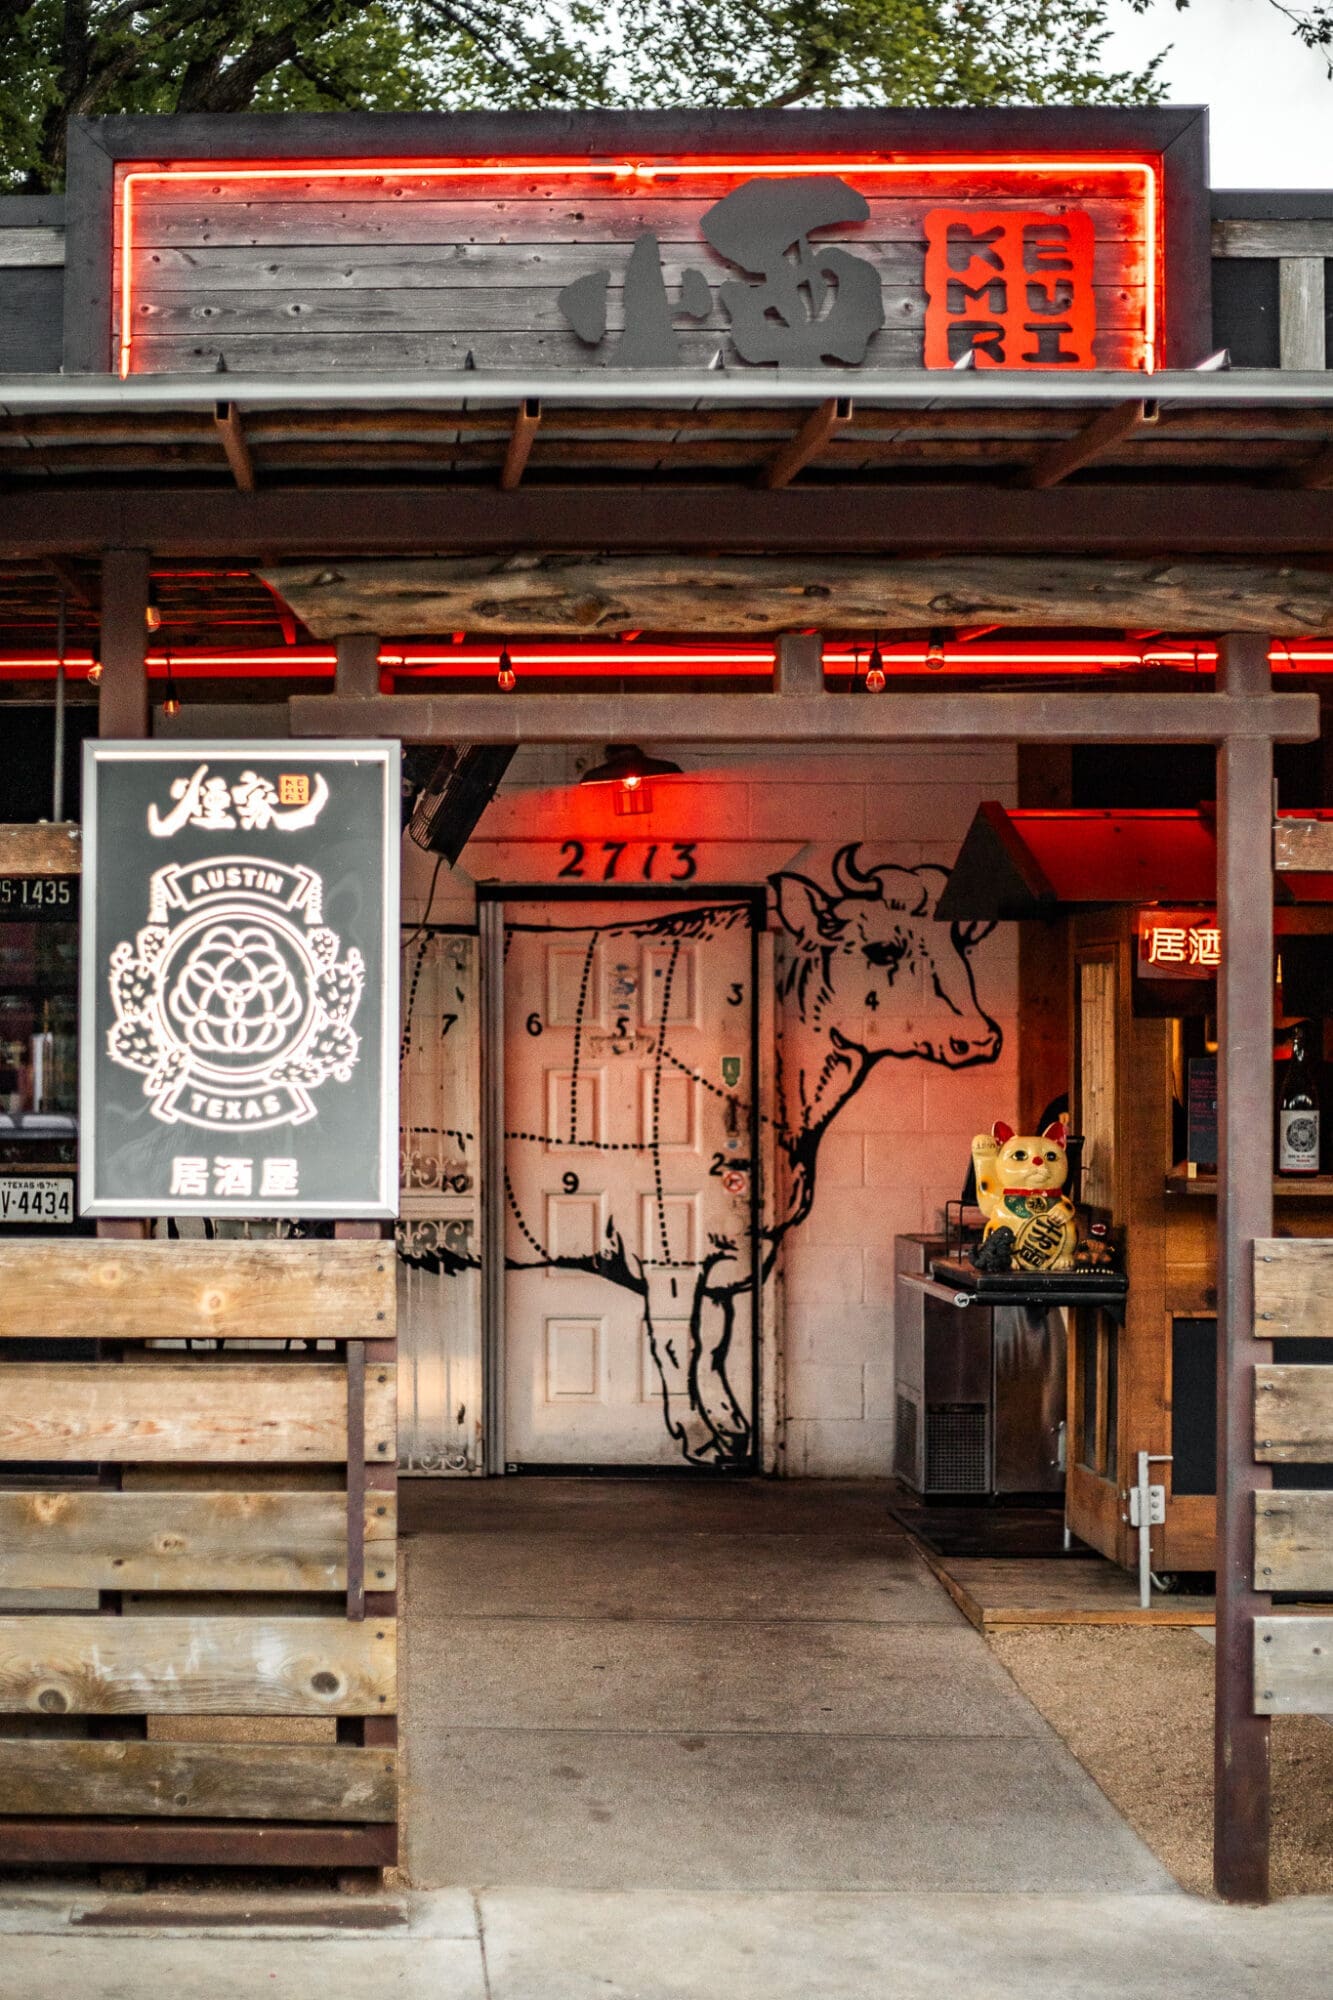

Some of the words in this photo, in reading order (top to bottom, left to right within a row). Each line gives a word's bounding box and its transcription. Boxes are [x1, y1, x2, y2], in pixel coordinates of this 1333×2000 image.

[946, 222, 1074, 274] KE
[946, 276, 1075, 316] MU
[946, 320, 1080, 364] RI
[557, 840, 697, 881] 2713
[191, 866, 284, 895] AUSTIN
[1148, 927, 1222, 965] 居酒
[727, 983, 744, 1006] 3
[864, 990, 879, 1011] 4
[442, 1014, 458, 1038] 7
[526, 1013, 543, 1036] 6
[615, 1016, 630, 1038] 5
[191, 1092, 281, 1120] TEXAS
[169, 1156, 299, 1196] 居酒屋
[709, 1153, 726, 1176] 2
[562, 1171, 580, 1194] 9
